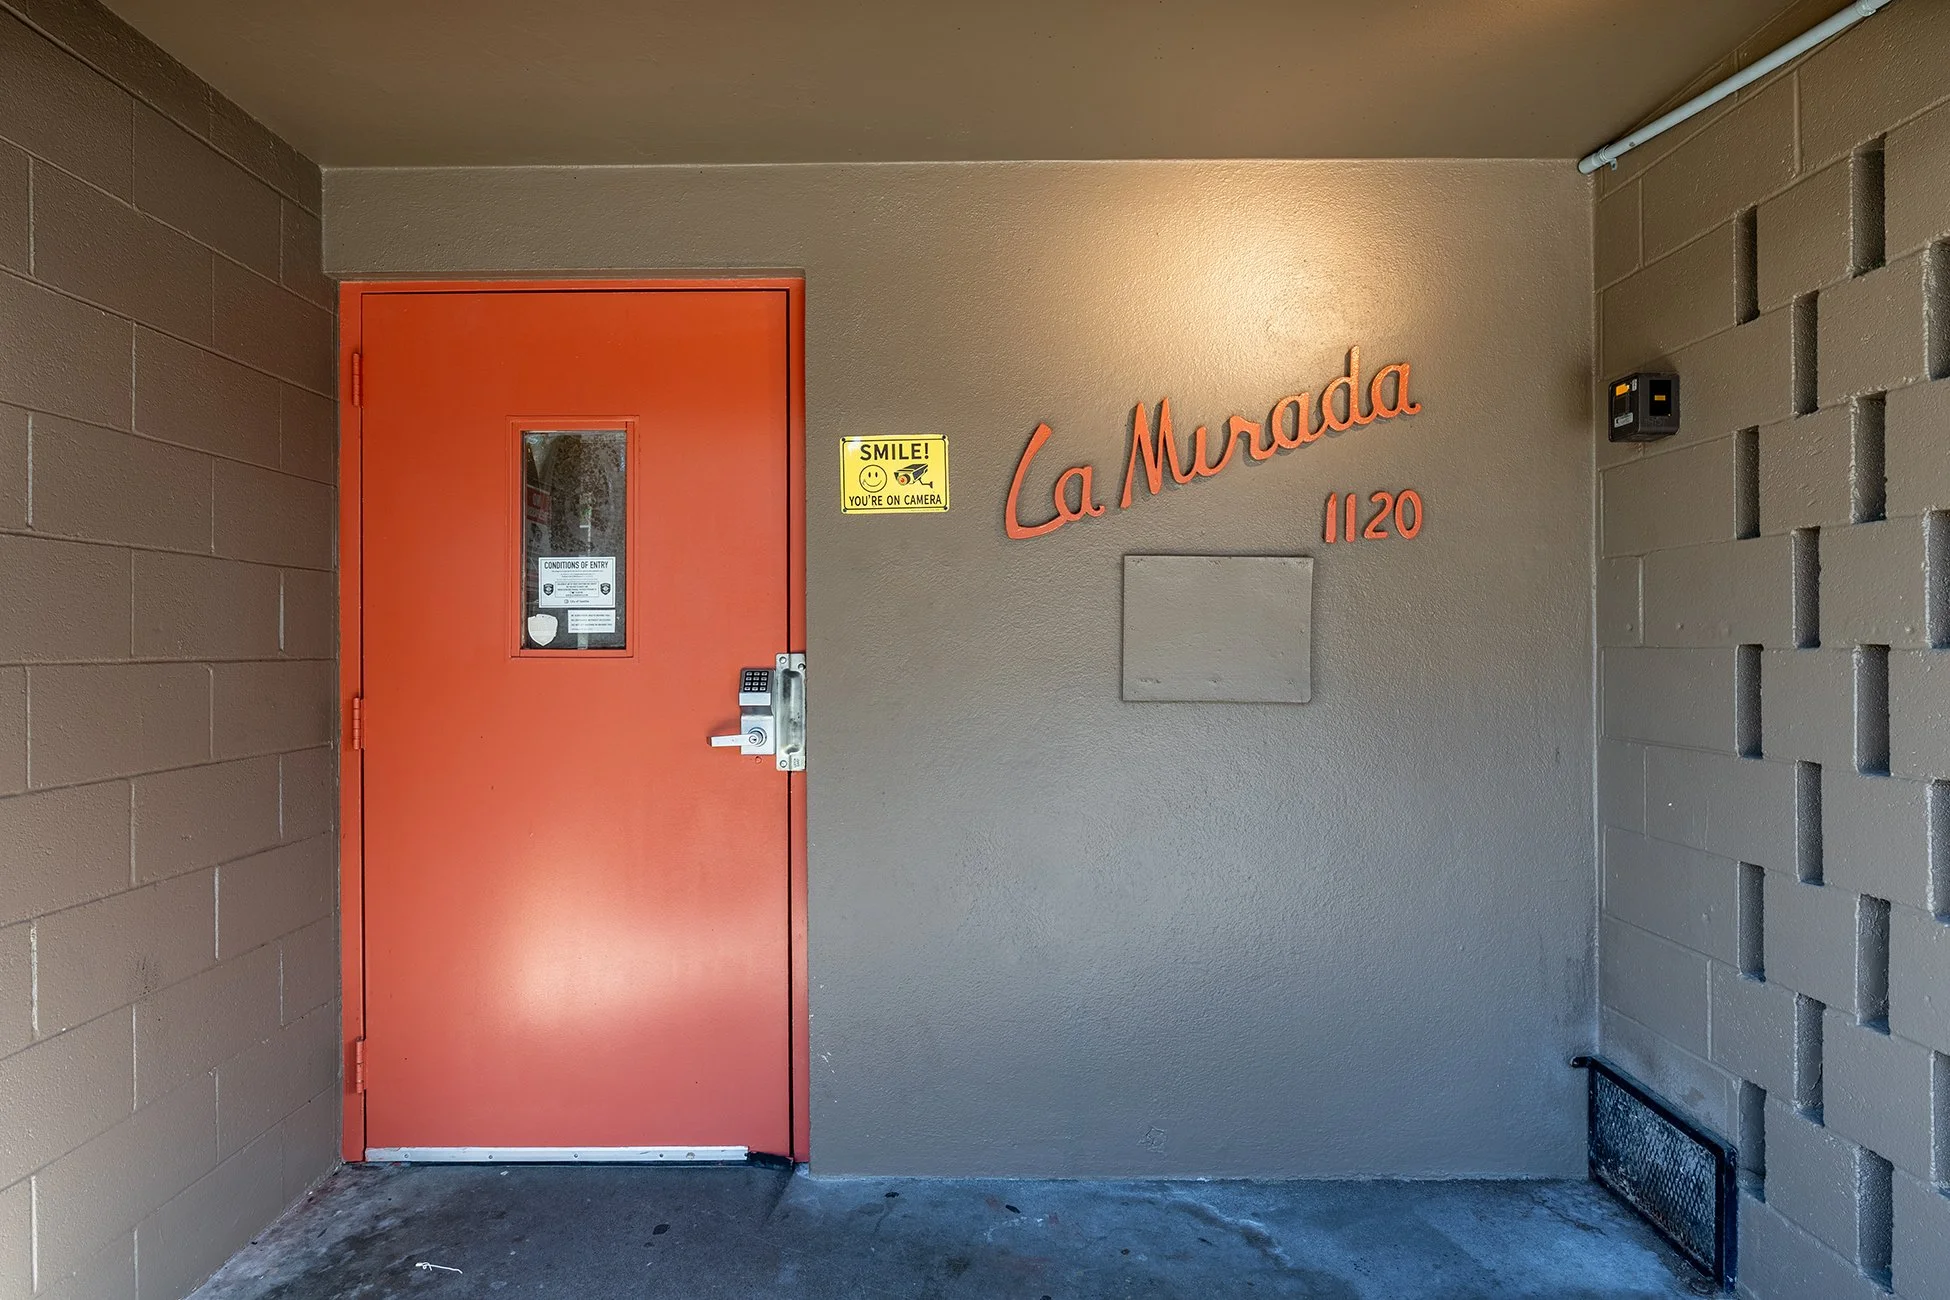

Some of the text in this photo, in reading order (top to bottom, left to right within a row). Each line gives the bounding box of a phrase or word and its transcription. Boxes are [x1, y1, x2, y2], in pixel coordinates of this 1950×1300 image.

[1005, 345, 1422, 539] La Mirada
[860, 443, 929, 460] SMILE!
[849, 494, 942, 506] YOU'RE ON CAMERA
[1324, 489, 1422, 543] 1120
[544, 561, 608, 569] CONDITIONS OF ENTRY
